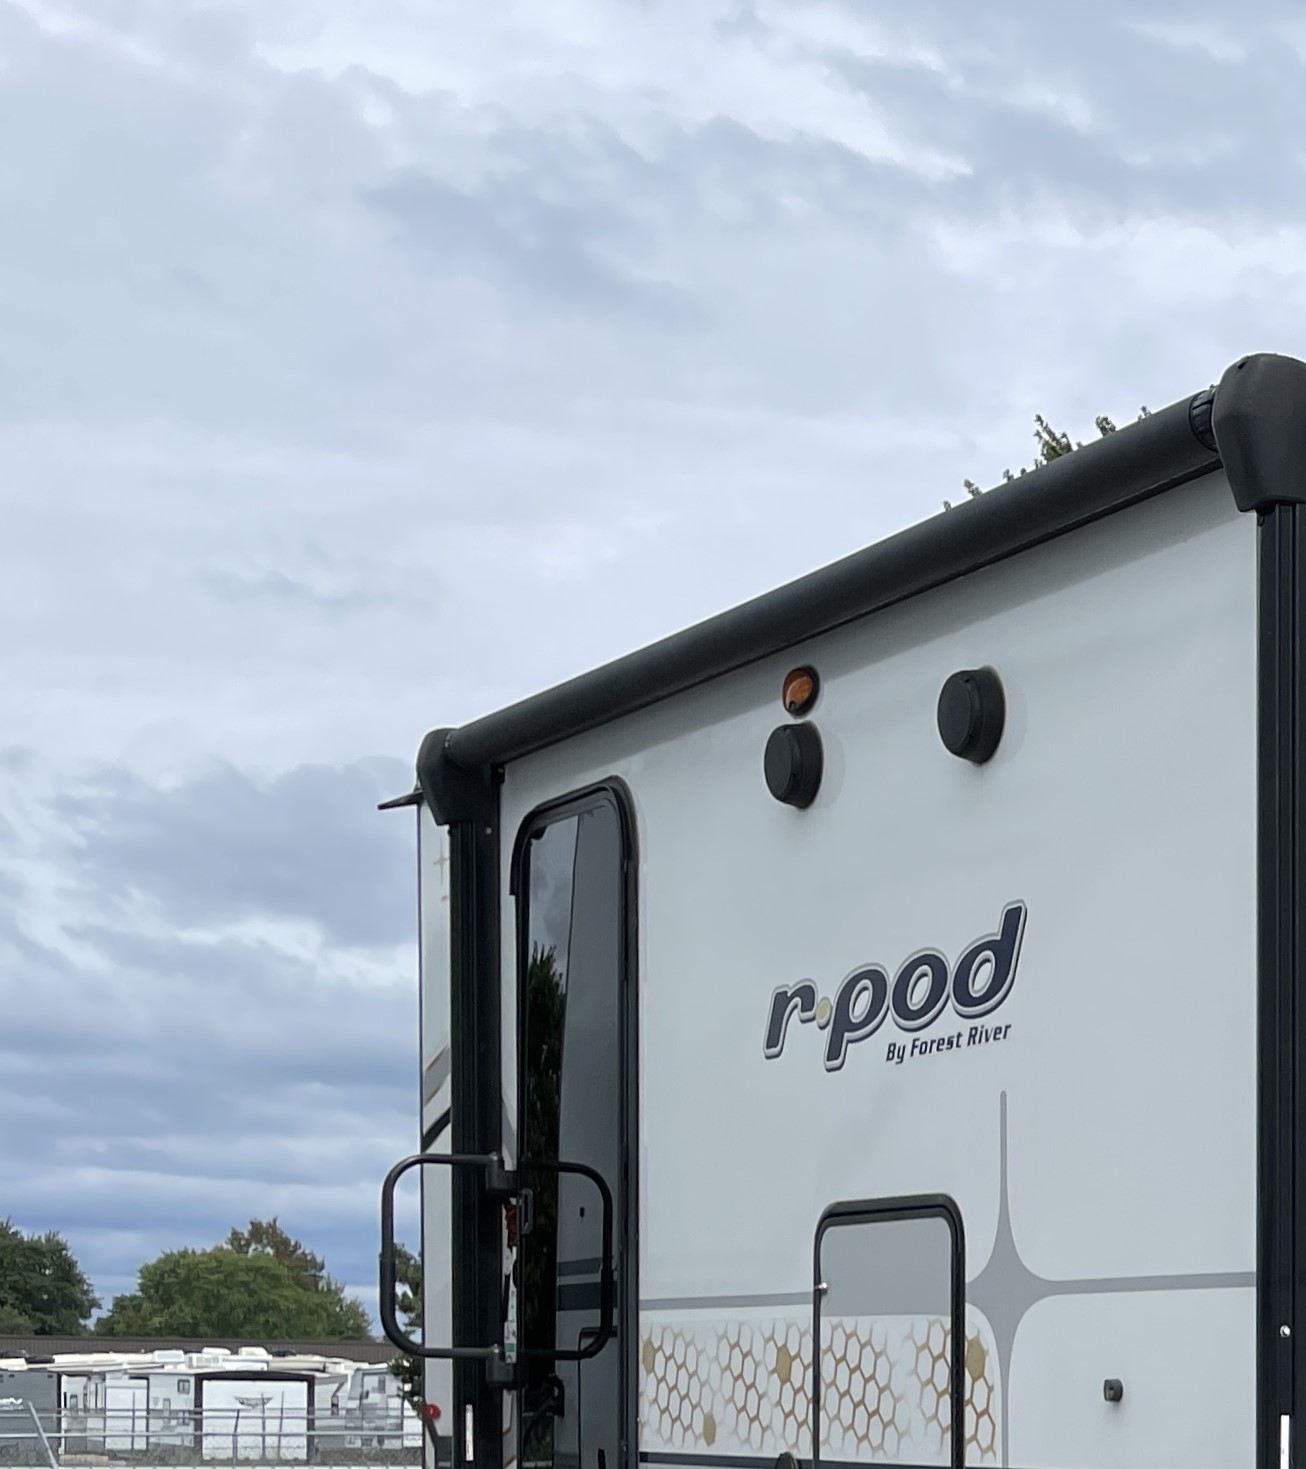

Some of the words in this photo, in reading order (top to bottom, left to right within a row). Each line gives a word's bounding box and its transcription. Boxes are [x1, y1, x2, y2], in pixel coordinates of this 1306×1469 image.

[886, 1042, 905, 1065] By
[910, 1031, 962, 1058] Forest
[967, 1023, 1012, 1046] River
